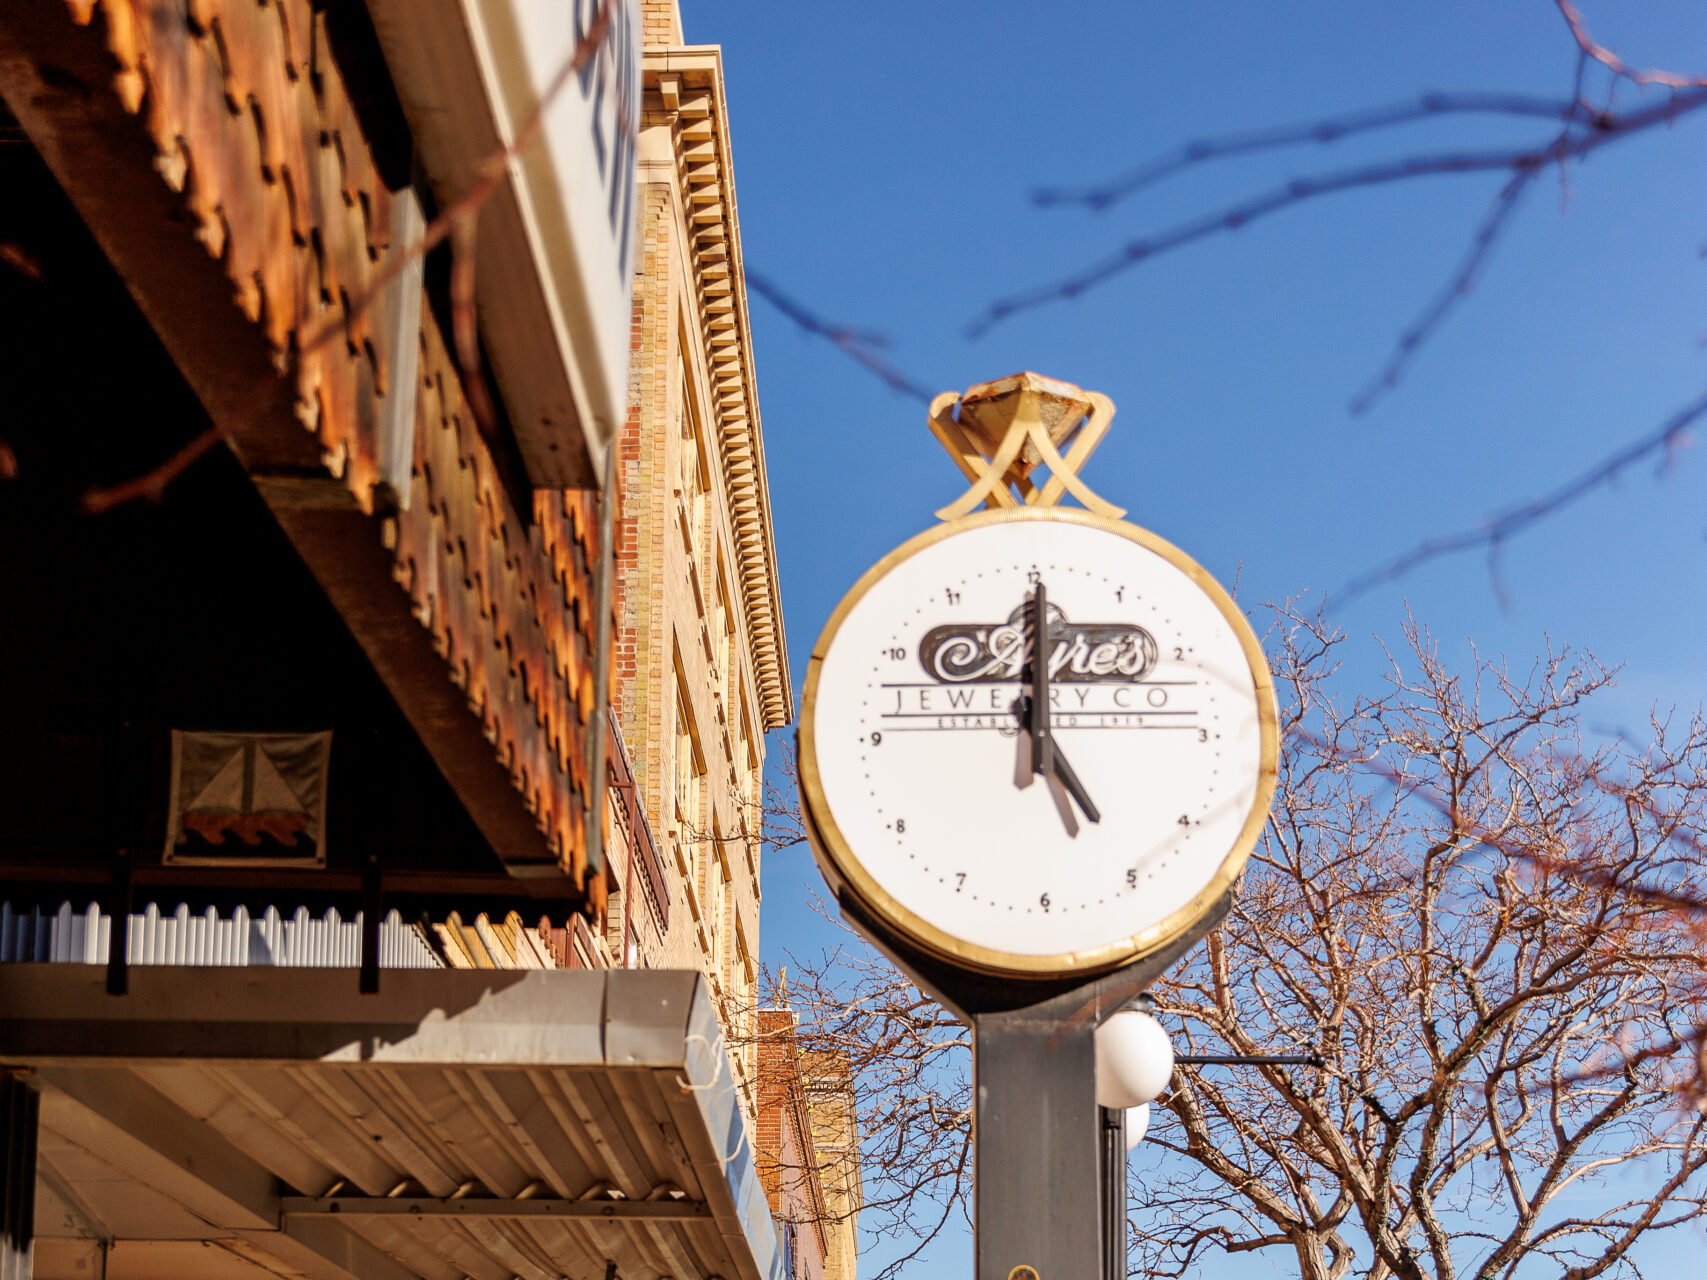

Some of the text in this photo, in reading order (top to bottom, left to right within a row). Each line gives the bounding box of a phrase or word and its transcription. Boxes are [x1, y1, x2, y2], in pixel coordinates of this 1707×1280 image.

[1027, 571, 1041, 584] 12
[947, 592, 960, 605] 11
[1115, 590, 1123, 603] 1
[890, 648, 906, 661] 10
[1173, 648, 1184, 661] 2
[1112, 686, 1170, 709] CO
[937, 714, 1077, 728] ESTABLED
[871, 732, 882, 746] 9
[1197, 729, 1208, 742] 3
[896, 819, 905, 833] 8
[1177, 815, 1189, 828] 4
[955, 873, 966, 886] 7
[1125, 869, 1137, 883] 5
[1040, 893, 1051, 908] 6
